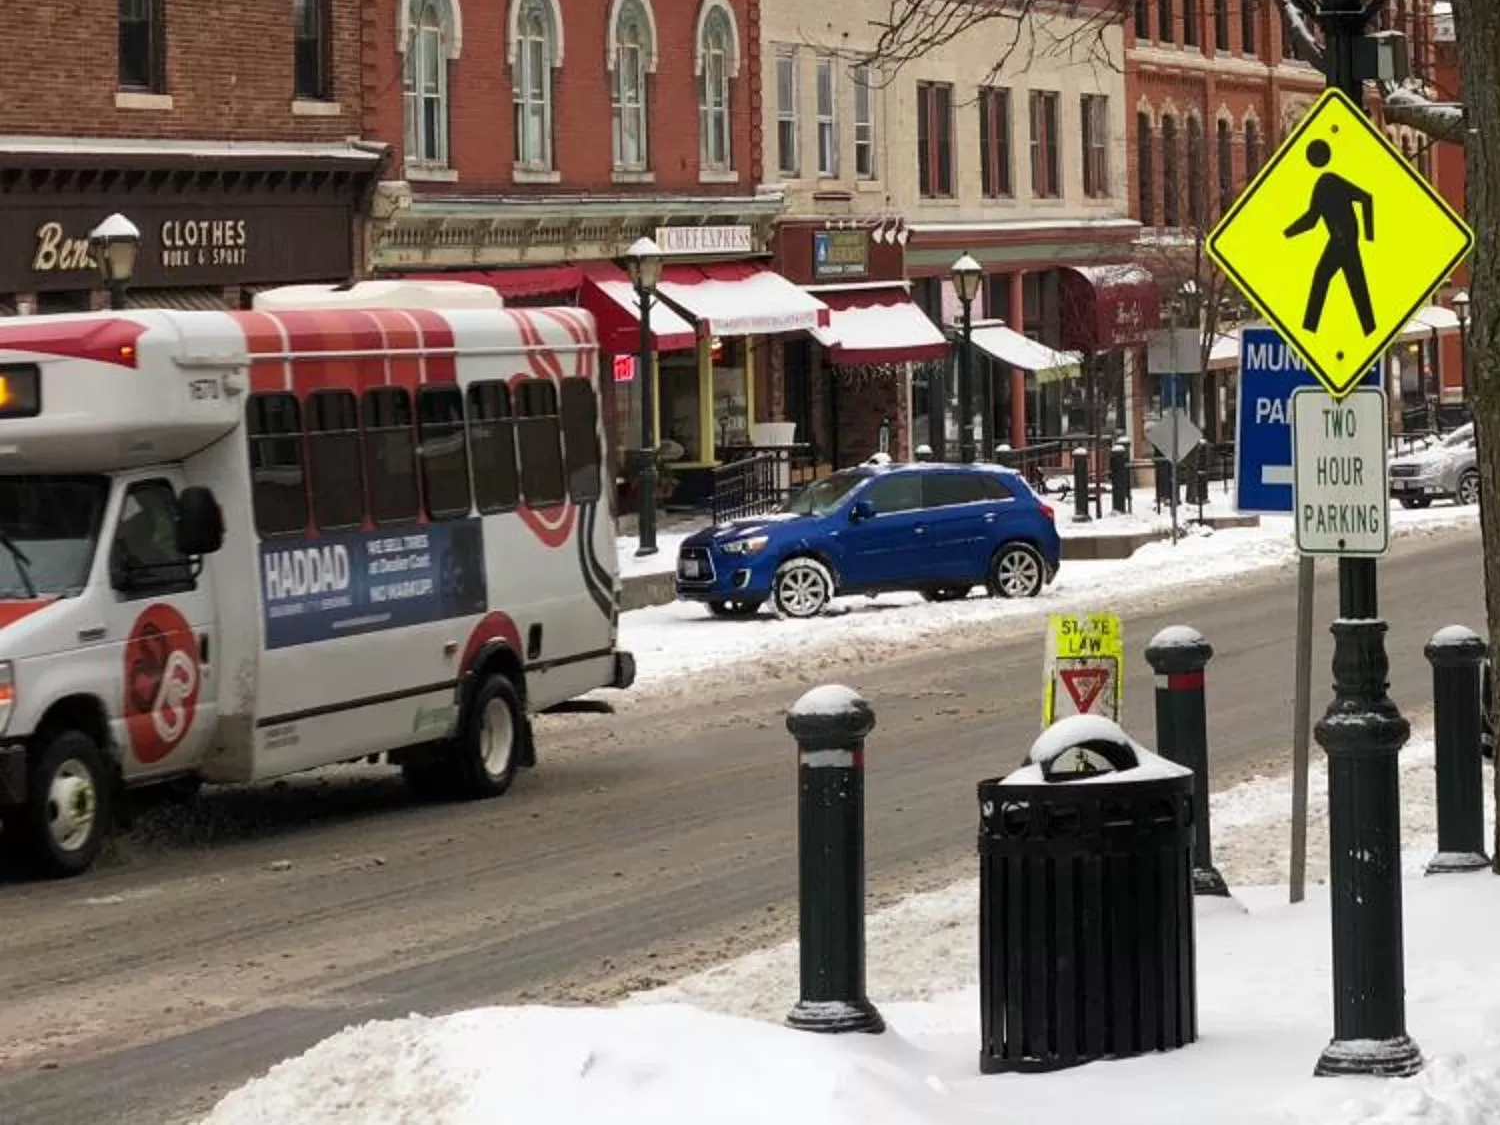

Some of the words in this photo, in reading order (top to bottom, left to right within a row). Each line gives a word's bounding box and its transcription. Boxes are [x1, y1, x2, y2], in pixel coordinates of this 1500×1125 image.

[32, 222, 98, 271] Ben
[161, 220, 246, 247] CLOTHES
[162, 250, 189, 267] WORK
[212, 248, 246, 264] SPORT
[1322, 408, 1357, 439] TWO
[1316, 457, 1364, 486] HOUR
[1303, 504, 1380, 534] PARKING
[264, 544, 349, 600] HADDAD
[1061, 619, 1110, 635] STTE
